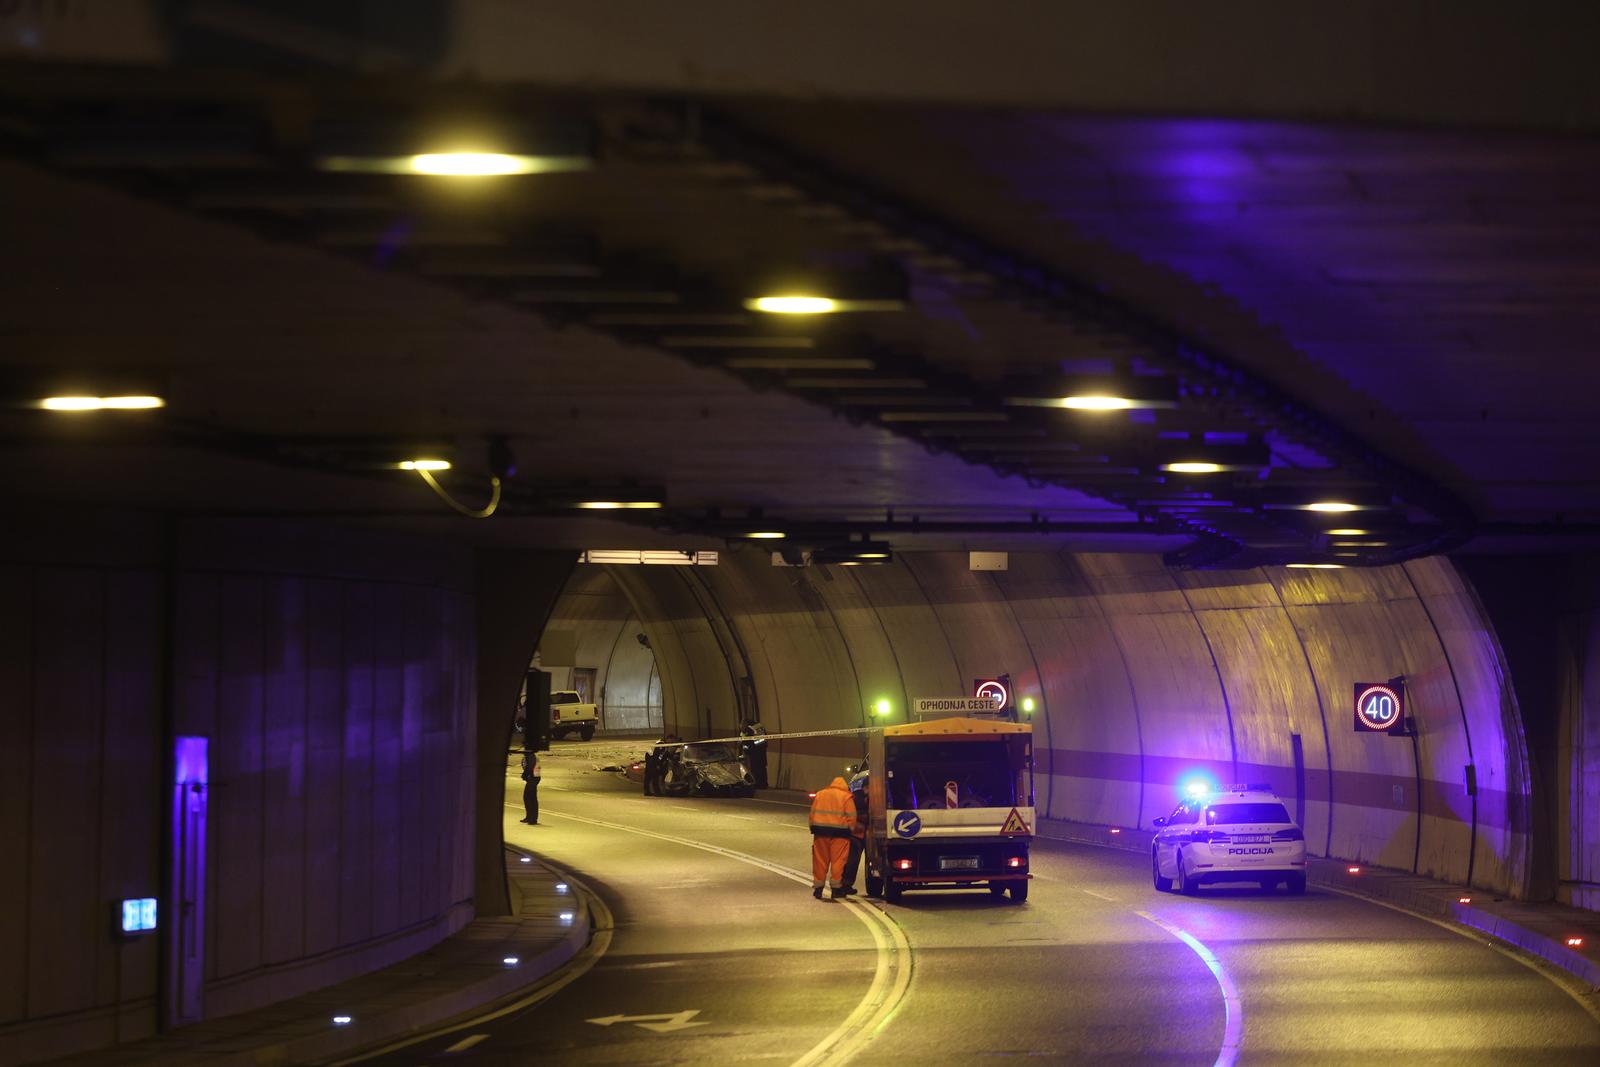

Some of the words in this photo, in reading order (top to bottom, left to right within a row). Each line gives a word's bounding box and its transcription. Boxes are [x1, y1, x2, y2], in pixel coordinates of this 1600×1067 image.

[920, 701, 965, 710] OPHODNJA
[968, 700, 994, 709] CESTE
[1365, 696, 1391, 719] 40
